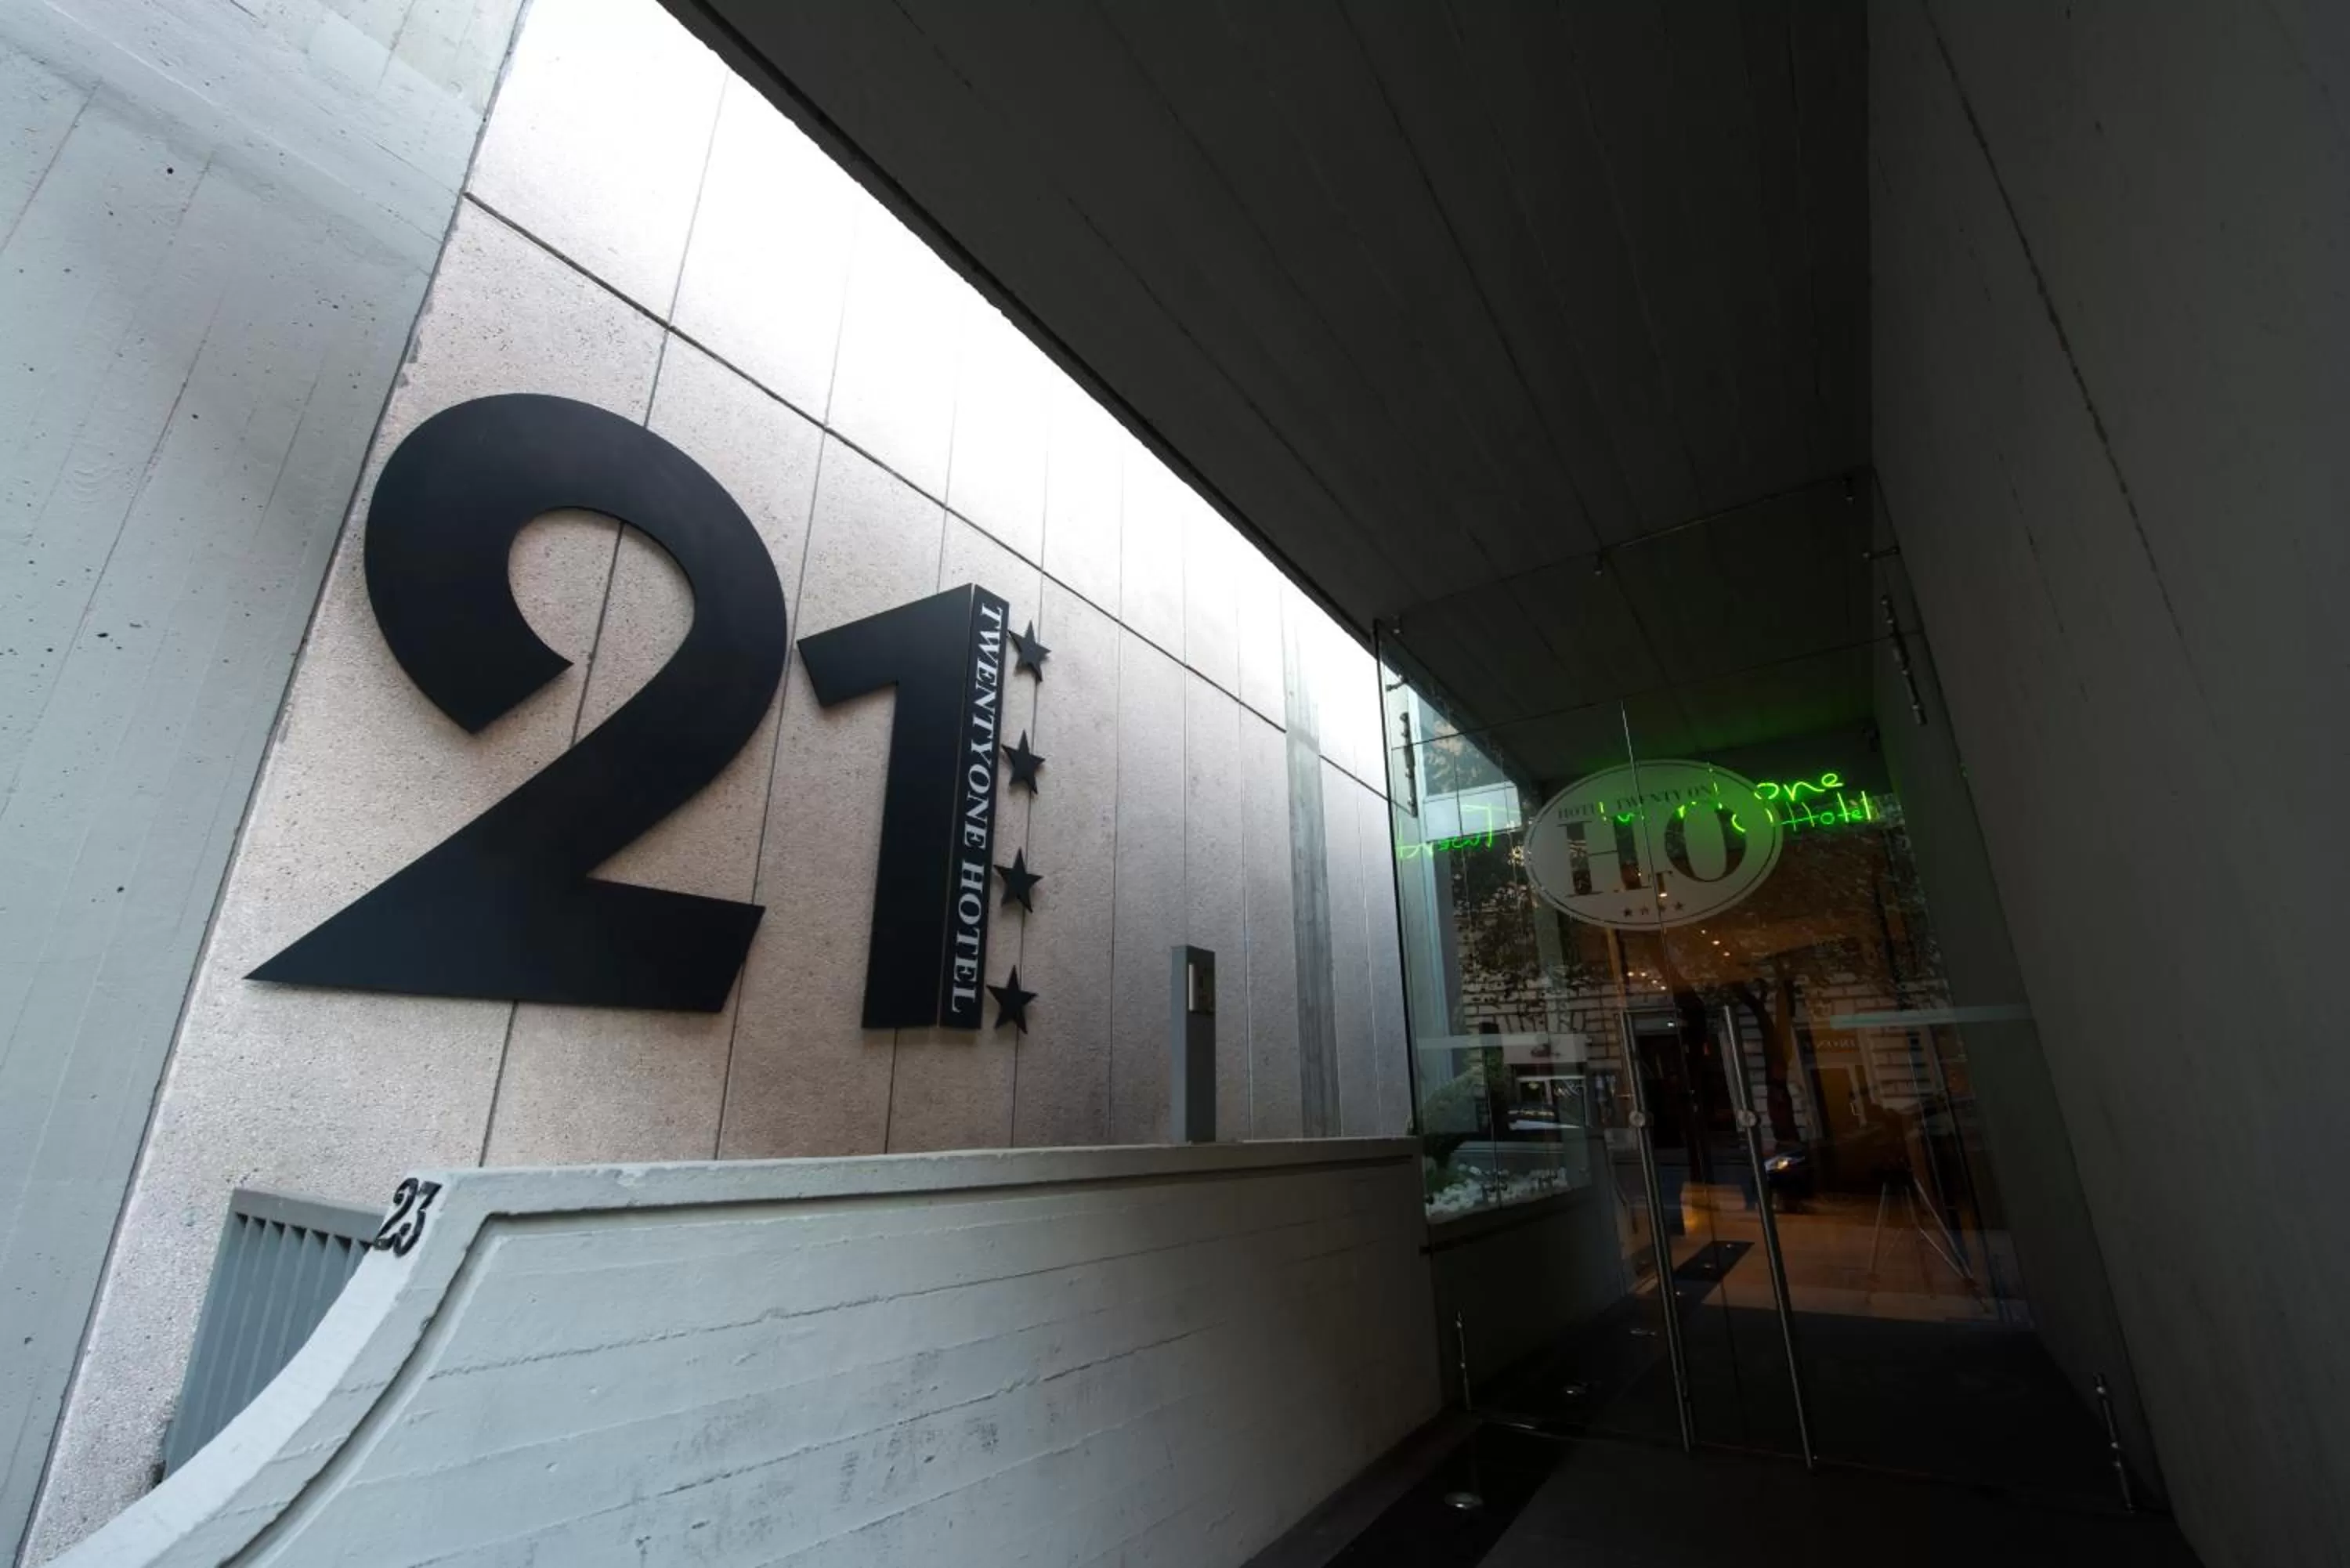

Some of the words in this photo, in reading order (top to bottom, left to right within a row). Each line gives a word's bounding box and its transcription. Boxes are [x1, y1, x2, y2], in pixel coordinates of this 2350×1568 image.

[244, 392, 1009, 1030] 21
[963, 602, 1003, 851] TWENTYONE
[1558, 802, 1606, 821] HOTE
[1687, 783, 1722, 799] ON
[952, 857, 984, 1015] HOTEL
[374, 1177, 442, 1258] 23
